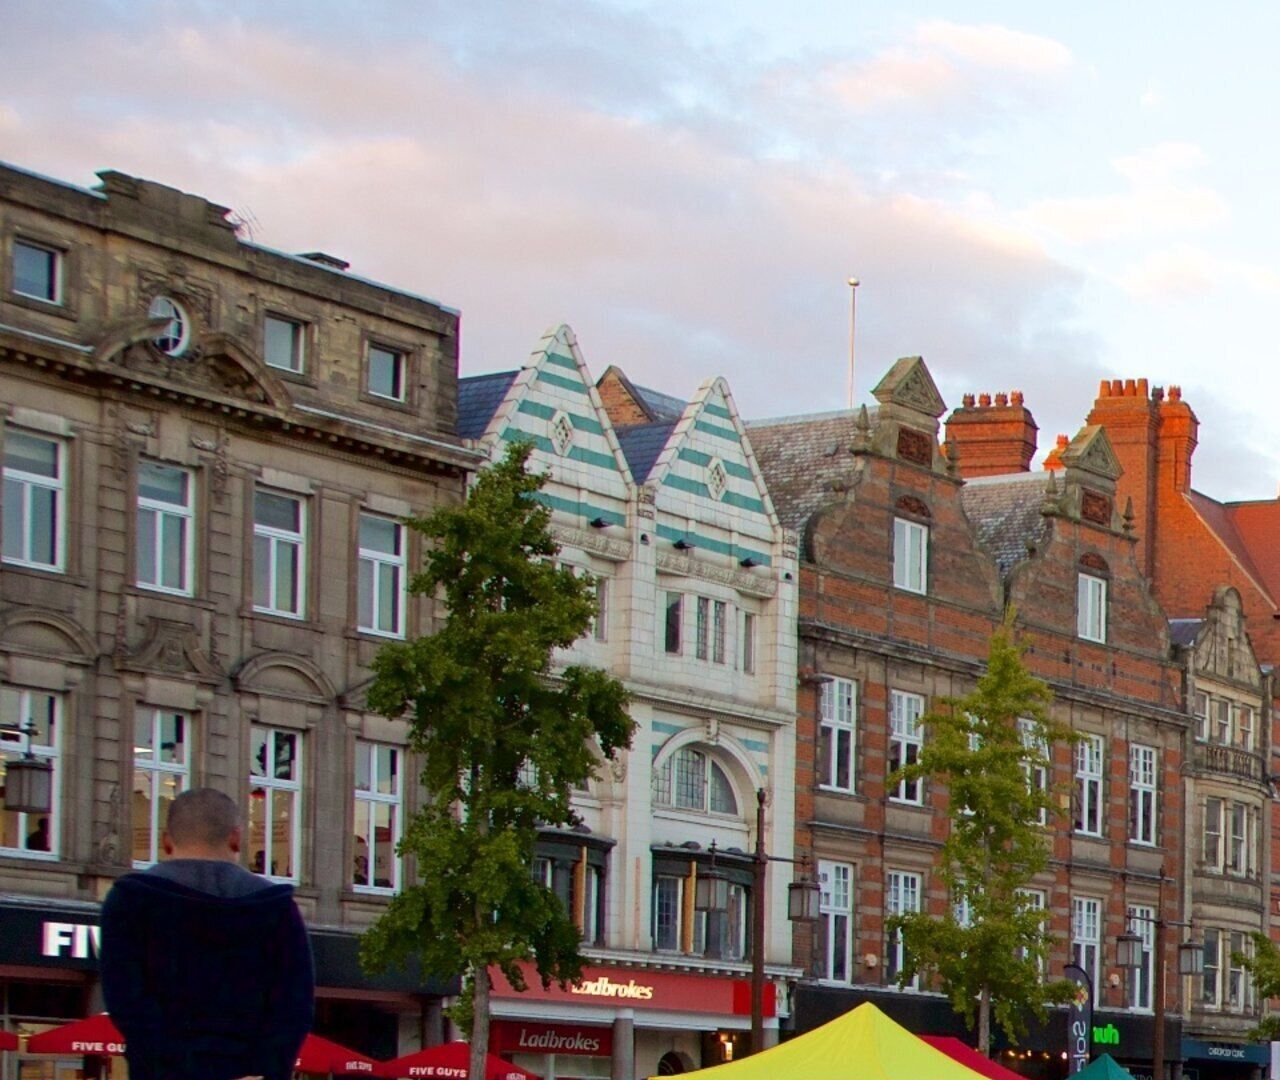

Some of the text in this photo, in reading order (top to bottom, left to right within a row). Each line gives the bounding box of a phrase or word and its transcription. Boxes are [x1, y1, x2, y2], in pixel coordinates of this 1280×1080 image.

[520, 1029, 599, 1051] Ladbrokes
[72, 1041, 103, 1052] FIVE
[409, 1067, 467, 1078] FIVE GUYS
